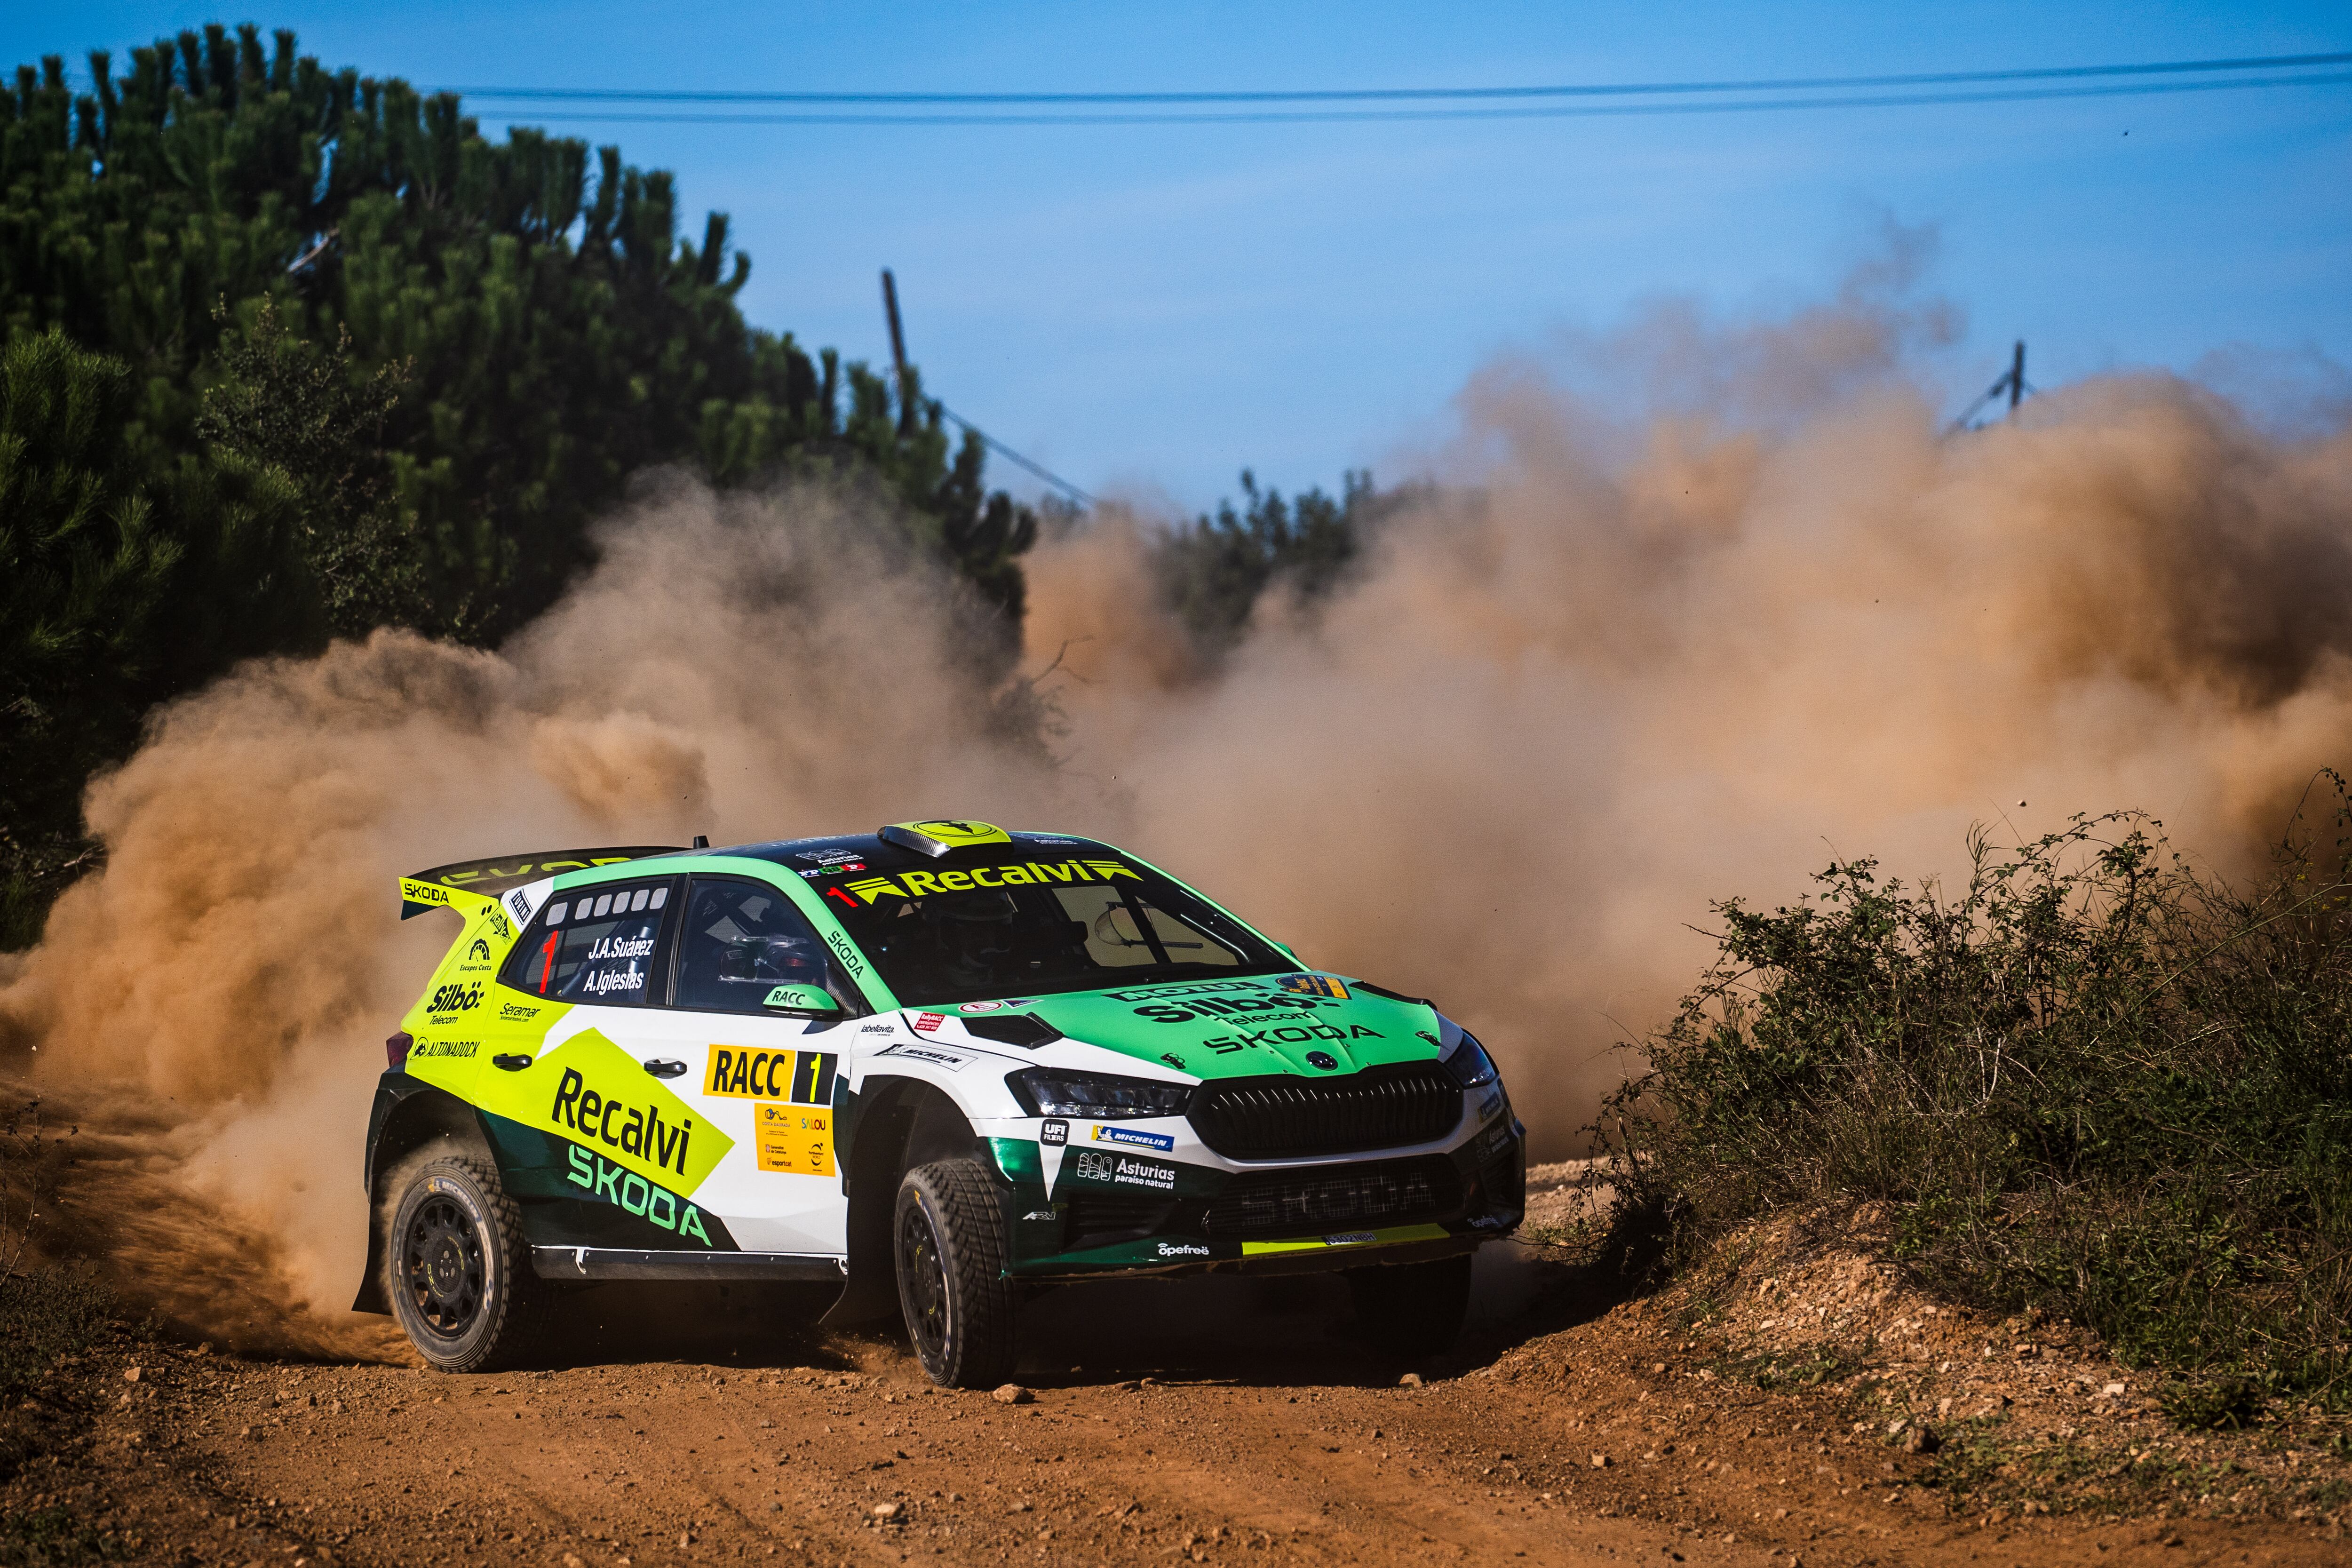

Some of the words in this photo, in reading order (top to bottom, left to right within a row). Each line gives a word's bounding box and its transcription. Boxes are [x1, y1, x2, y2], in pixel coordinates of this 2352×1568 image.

[826, 887, 858, 908] 1
[897, 860, 1095, 896] Recalvi
[512, 892, 530, 920] TURINI
[539, 930, 559, 994] 1
[771, 990, 806, 1005] RACC
[1117, 982, 1252, 1002] MOTUL
[500, 1003, 541, 1018] Seramar
[1213, 1011, 1316, 1026] Telecom
[429, 1015, 459, 1026] Telecom
[427, 1041, 480, 1058] ALTONADOCK
[905, 1049, 962, 1064] MICHELIN
[713, 1050, 785, 1097] RACC
[810, 1053, 821, 1103] 1
[551, 1066, 692, 1176] Recalvi
[802, 1118, 826, 1130] SALOU
[1045, 1123, 1065, 1135] UFI
[1114, 1132, 1167, 1146] MICHELIN
[1116, 1158, 1175, 1181] Asturias
[1115, 1174, 1144, 1185] paraíso
[1145, 1178, 1174, 1190] natural
